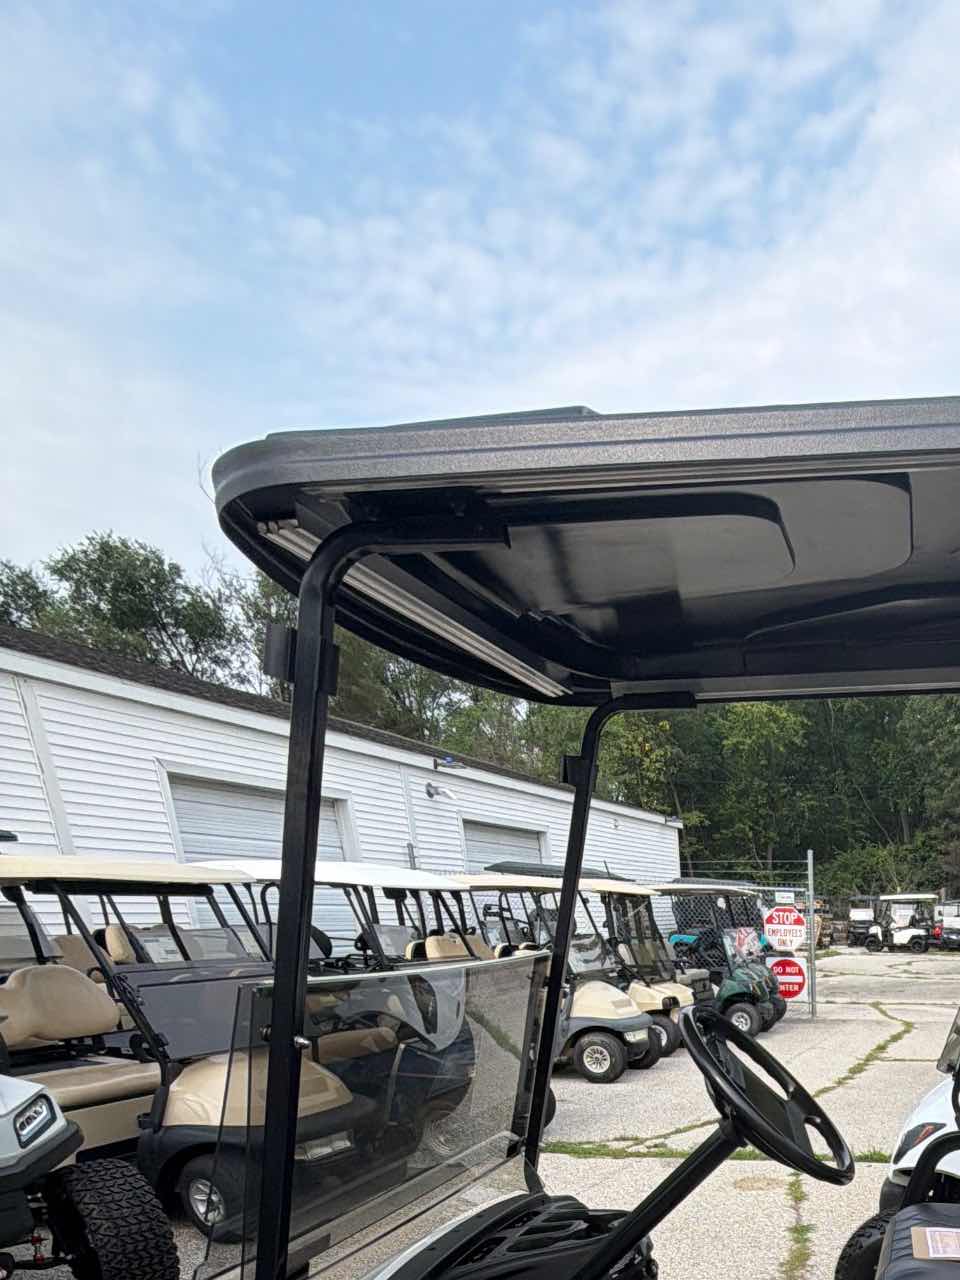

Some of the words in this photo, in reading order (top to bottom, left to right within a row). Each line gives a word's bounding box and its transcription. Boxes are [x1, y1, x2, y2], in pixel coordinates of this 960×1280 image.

[772, 911, 798, 925] STOP
[767, 928, 803, 938] EMPLOYEES
[777, 939, 794, 947] ONLY
[773, 966, 783, 974] DO
[785, 966, 800, 974] NOT
